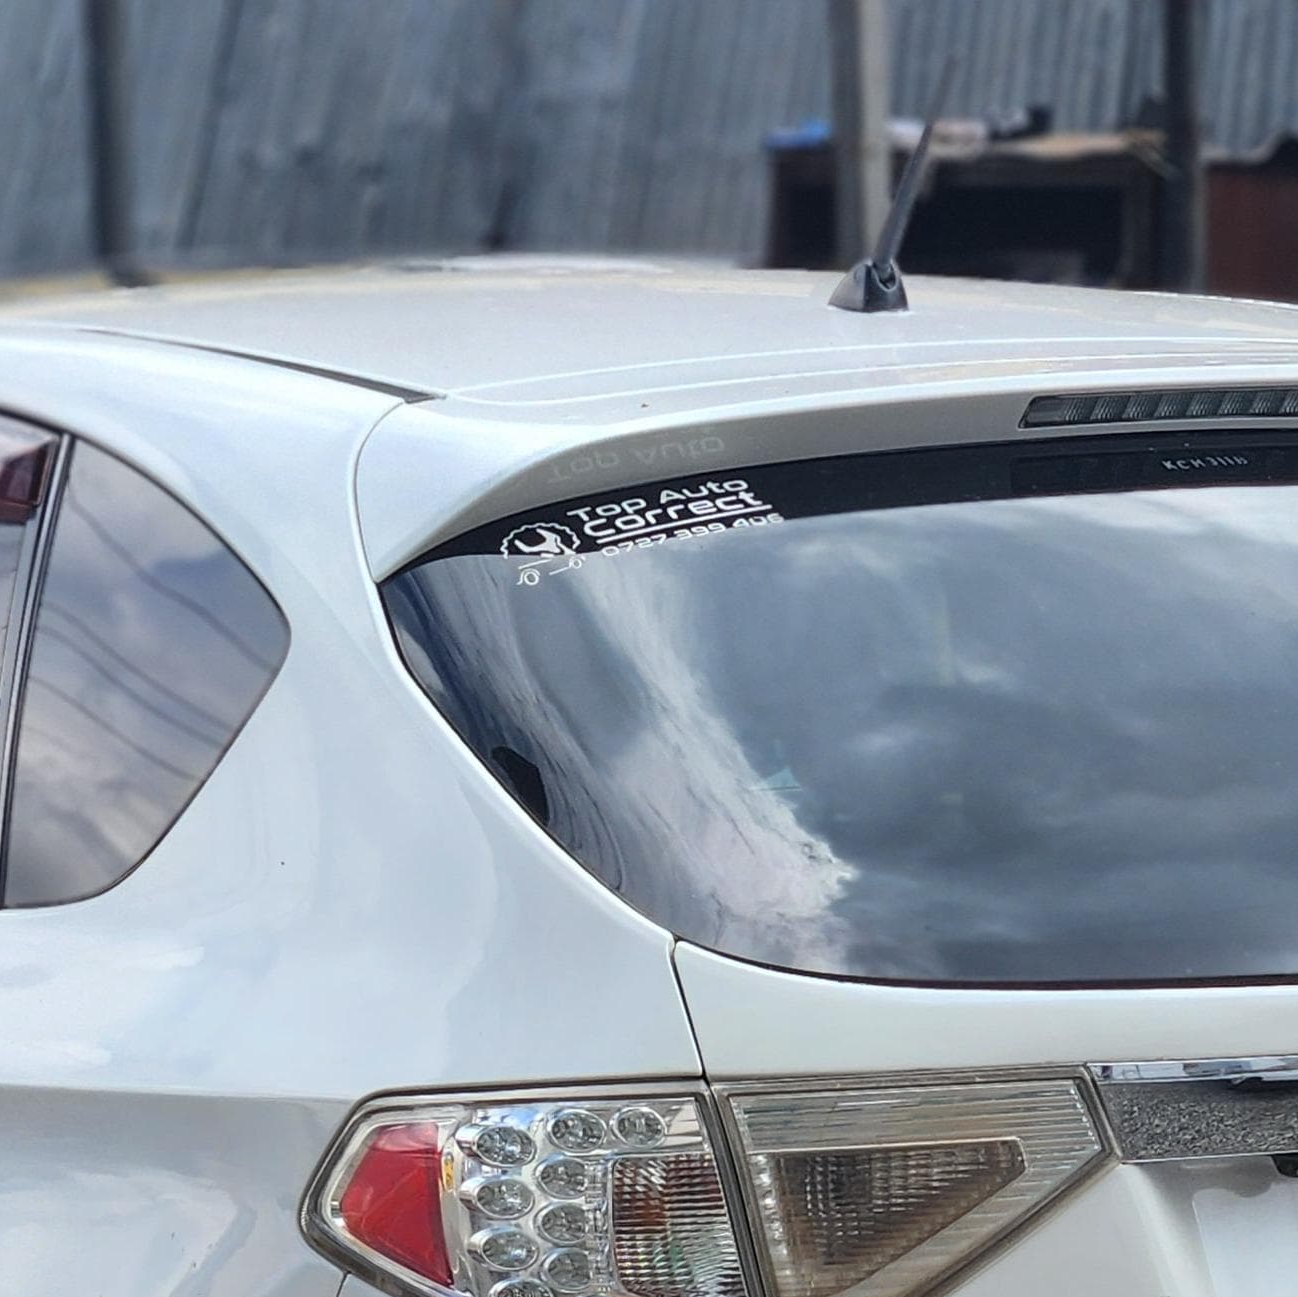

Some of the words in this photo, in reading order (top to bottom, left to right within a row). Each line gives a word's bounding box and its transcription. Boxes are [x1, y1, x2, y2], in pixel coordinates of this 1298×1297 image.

[566, 498, 647, 522] Top
[660, 479, 749, 505] Auto
[583, 491, 765, 537] Correct
[601, 533, 667, 557] 0727
[673, 522, 727, 541] 399
[732, 513, 785, 529] 406
